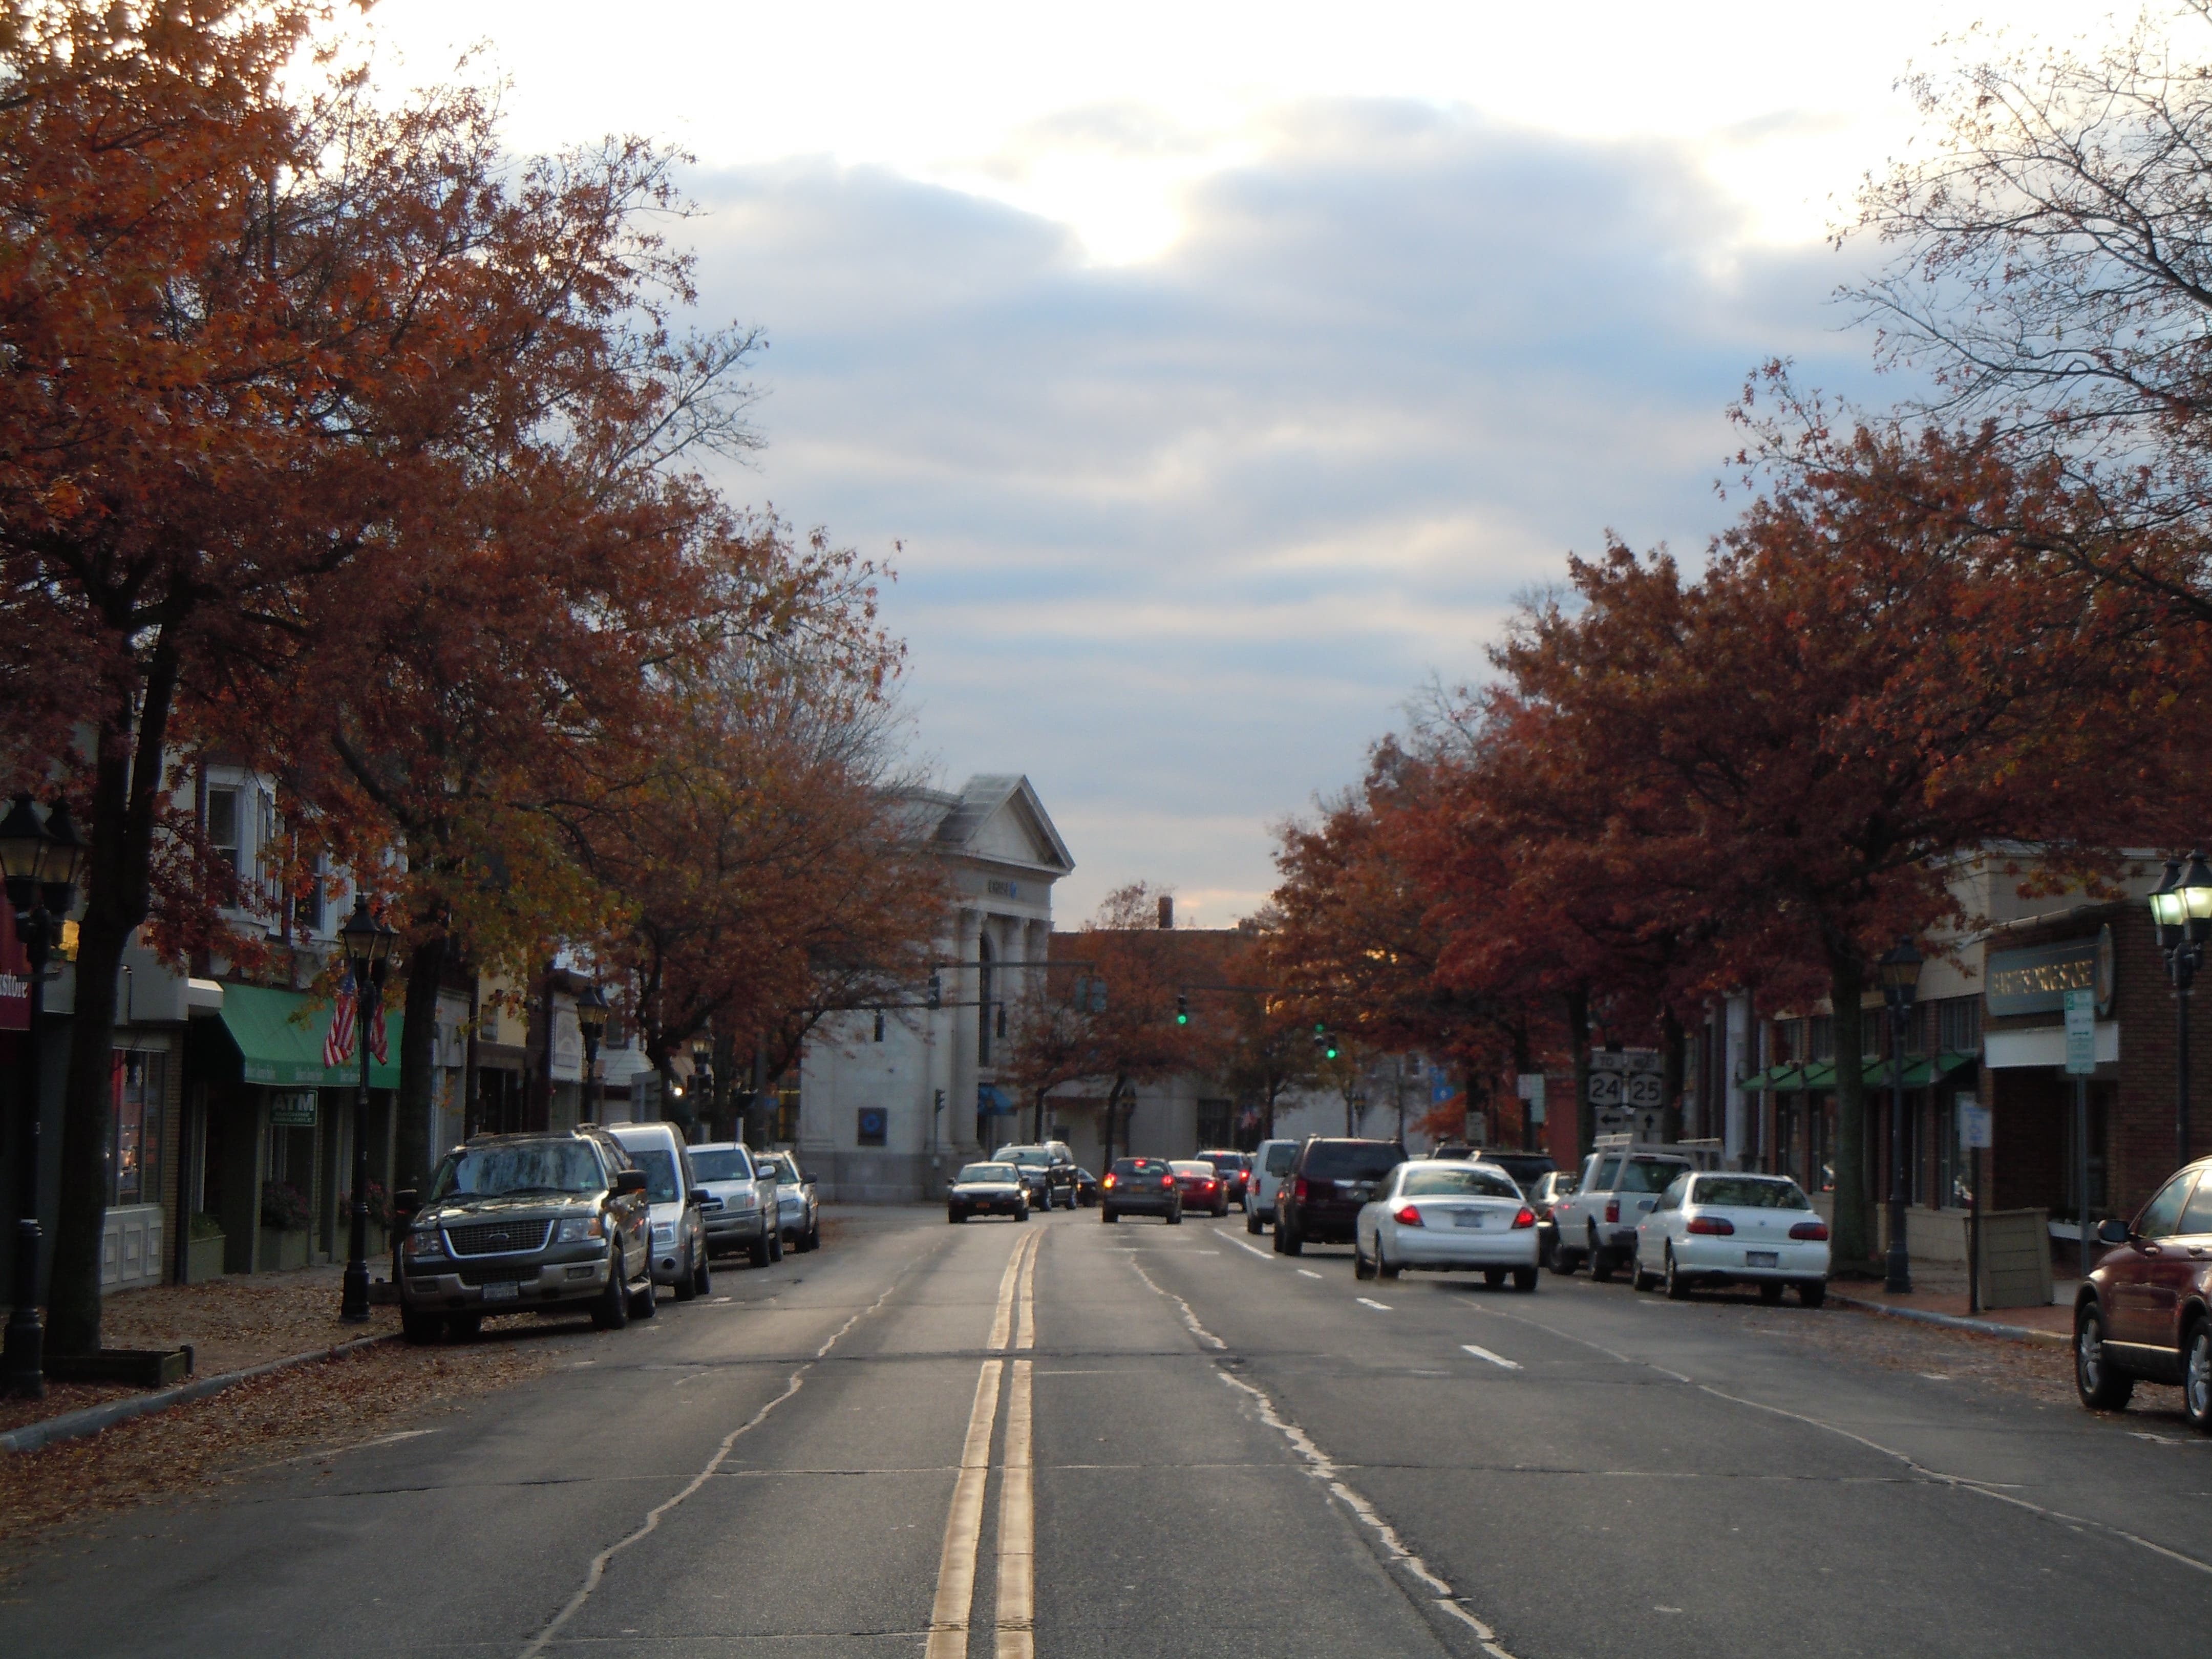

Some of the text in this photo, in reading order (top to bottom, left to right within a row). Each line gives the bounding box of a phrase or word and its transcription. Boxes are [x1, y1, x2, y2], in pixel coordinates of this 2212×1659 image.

[1601, 1056, 1613, 1066] TO
[1592, 1078, 1618, 1098] 24
[1634, 1081, 1659, 1100] 25
[272, 1093, 315, 1111] ATM
